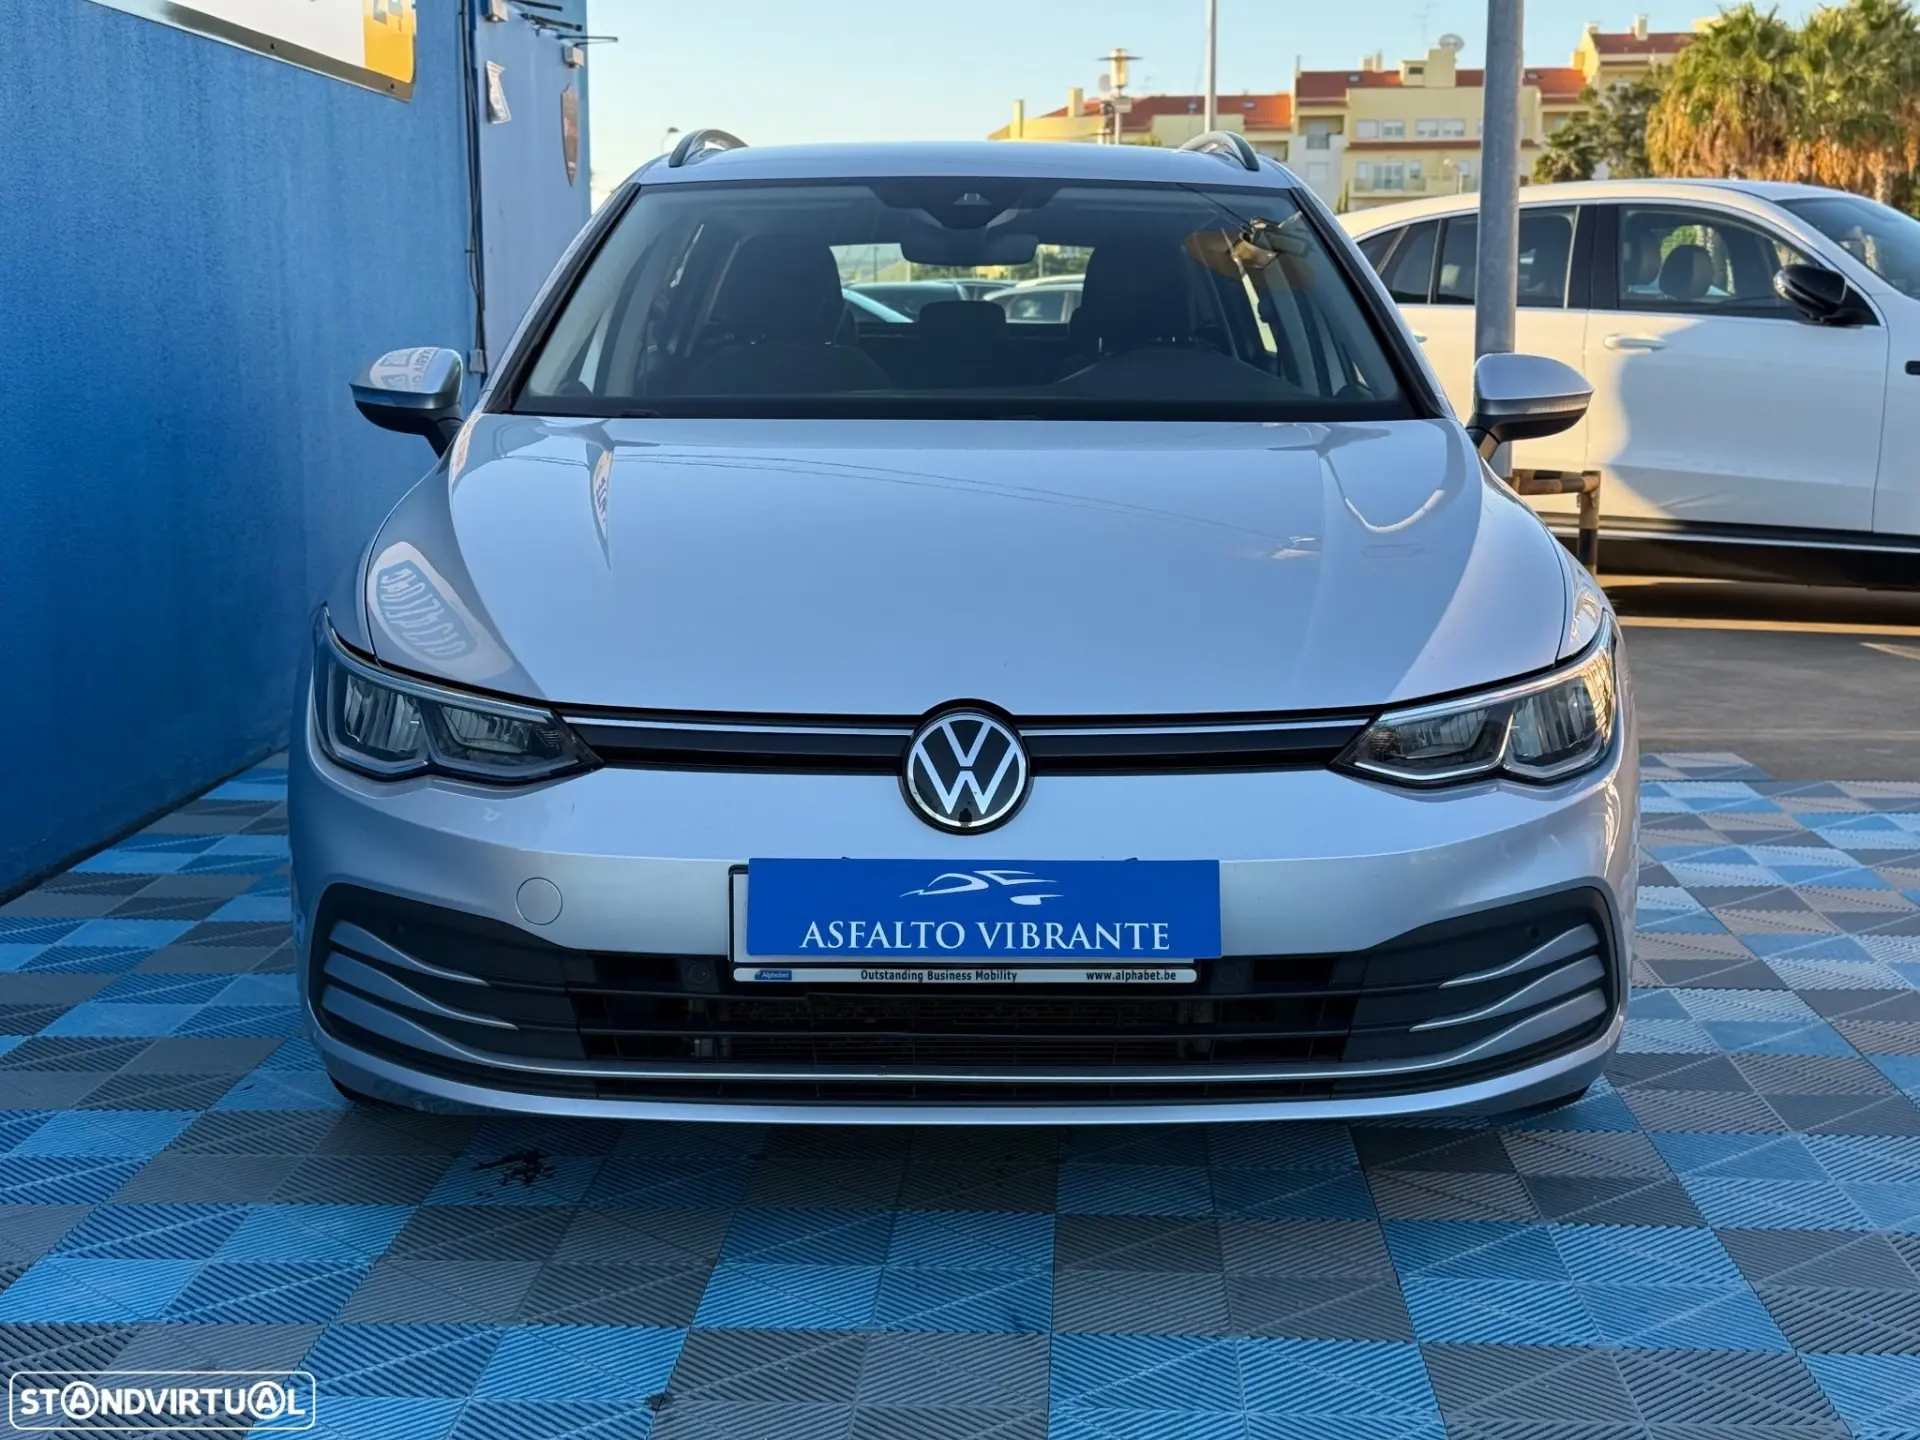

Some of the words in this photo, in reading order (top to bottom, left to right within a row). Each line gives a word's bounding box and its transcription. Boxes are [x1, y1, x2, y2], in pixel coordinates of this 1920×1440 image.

[799, 920, 966, 949] ASFALTO
[975, 921, 1170, 950] VIBRANTE
[860, 969, 924, 983] Outstanding
[927, 969, 972, 981] Business
[975, 969, 1018, 983] Mobility
[1086, 969, 1177, 983] www.alphabet.be
